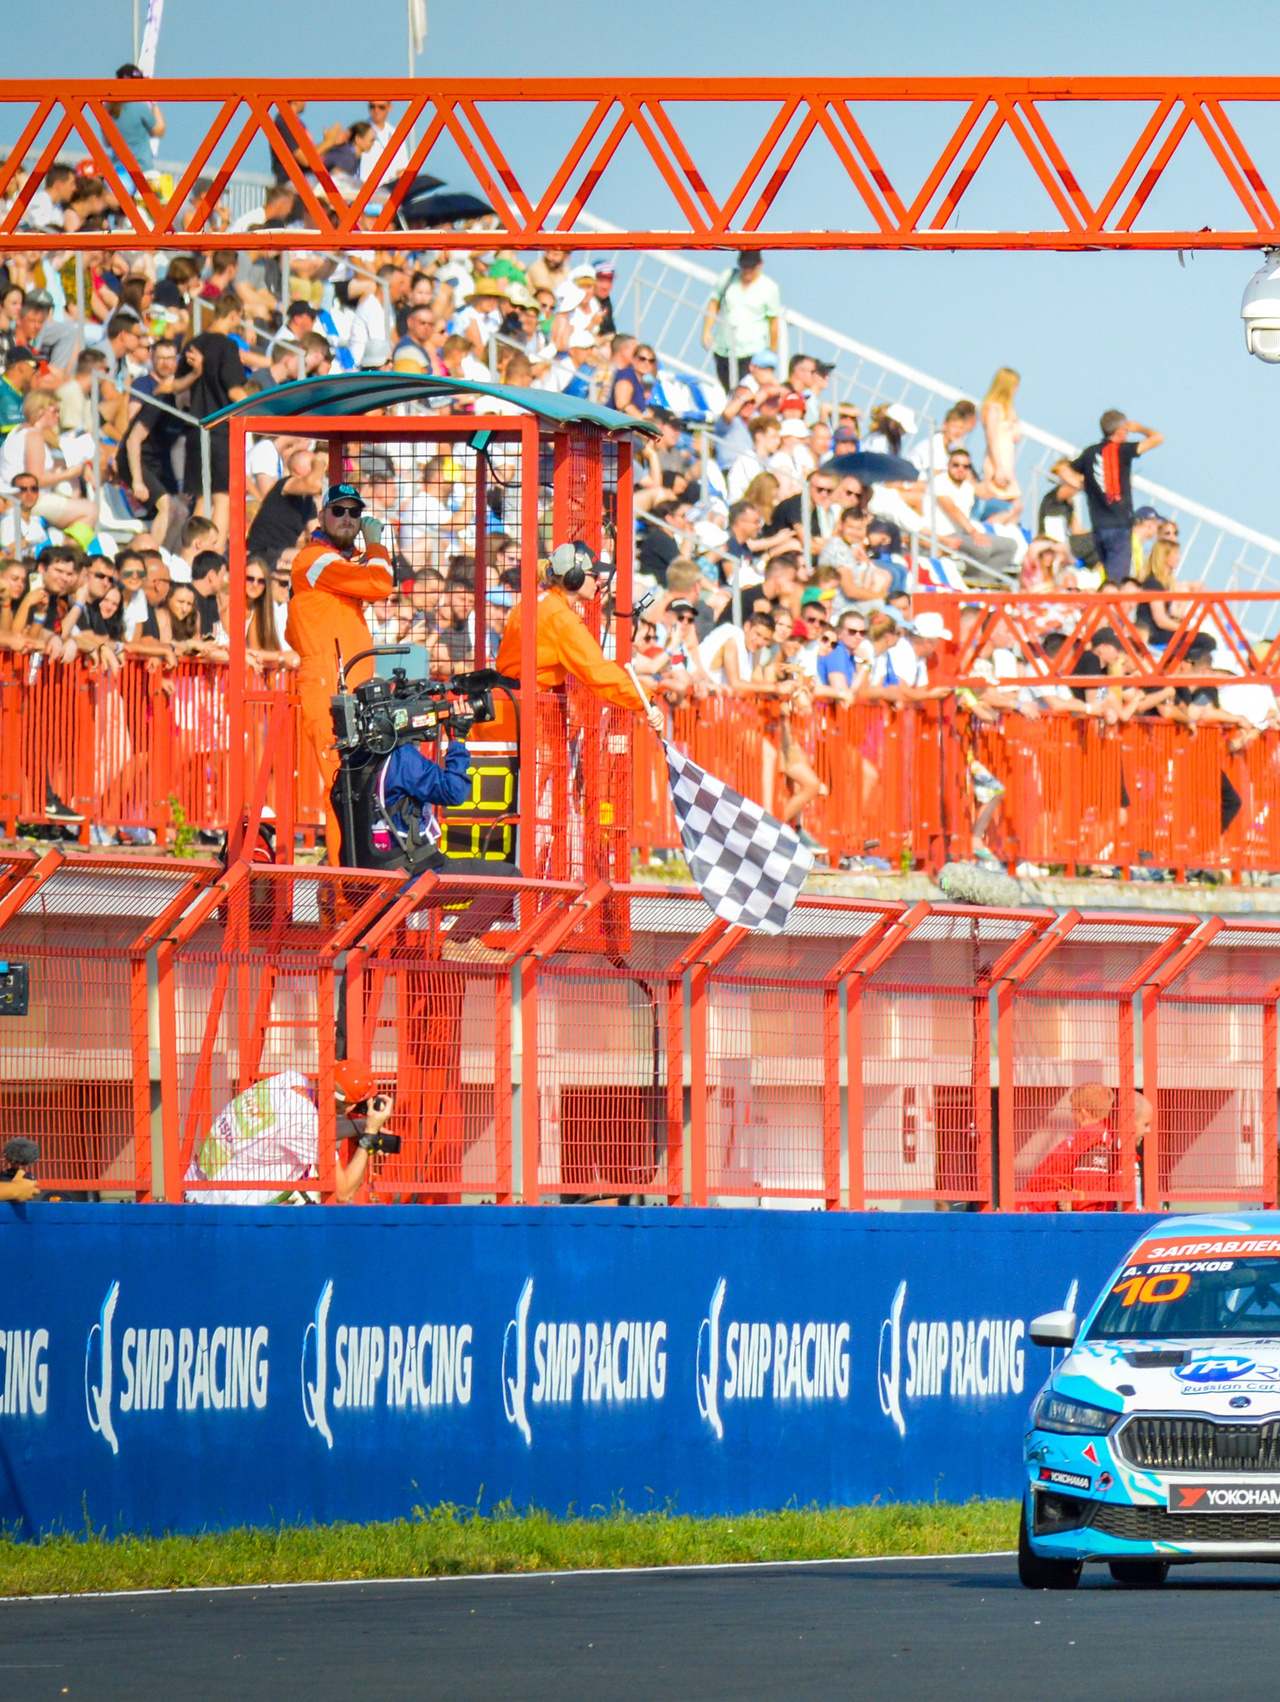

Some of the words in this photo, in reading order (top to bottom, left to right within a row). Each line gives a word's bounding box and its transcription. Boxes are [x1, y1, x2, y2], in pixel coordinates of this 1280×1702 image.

[1112, 1272, 1191, 1307] 10
[1146, 1261, 1234, 1275] ПЕТУХОВ
[120, 1327, 175, 1411] SMP
[176, 1326, 269, 1410] RACING
[333, 1325, 385, 1408] SMP
[386, 1324, 473, 1406] RACING
[532, 1321, 580, 1403] SMP
[582, 1320, 667, 1401] RACING
[724, 1322, 772, 1399] SMP
[773, 1321, 850, 1399] RACING
[906, 1321, 949, 1397] SMP
[950, 1320, 1025, 1396] RACING
[1184, 1384, 1241, 1393] Russian
[1246, 1382, 1274, 1391] Car
[1050, 1471, 1090, 1489] YOKOHAMA
